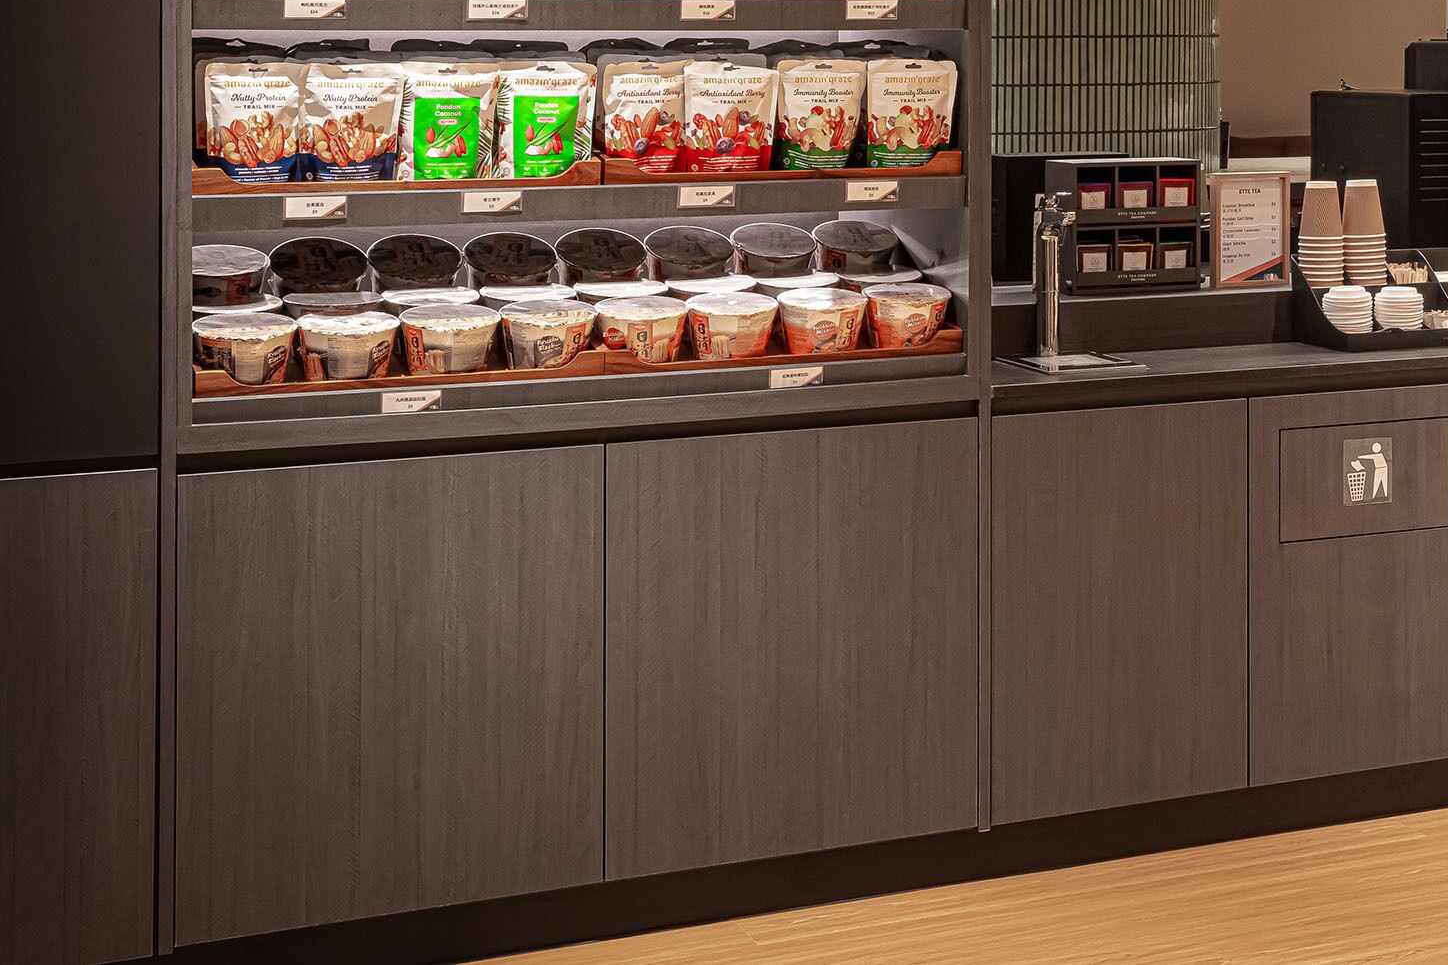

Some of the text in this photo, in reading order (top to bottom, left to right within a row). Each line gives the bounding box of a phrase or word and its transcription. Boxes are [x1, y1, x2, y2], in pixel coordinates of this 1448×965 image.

[617, 89, 681, 98] Antioxidant Berry
[699, 89, 765, 98] Antioxidant Berry
[793, 88, 854, 98] Immunity Booster
[883, 89, 916, 98] Immunity
[230, 93, 286, 104] Nutty Protein
[323, 94, 378, 104] Nutty Protein
